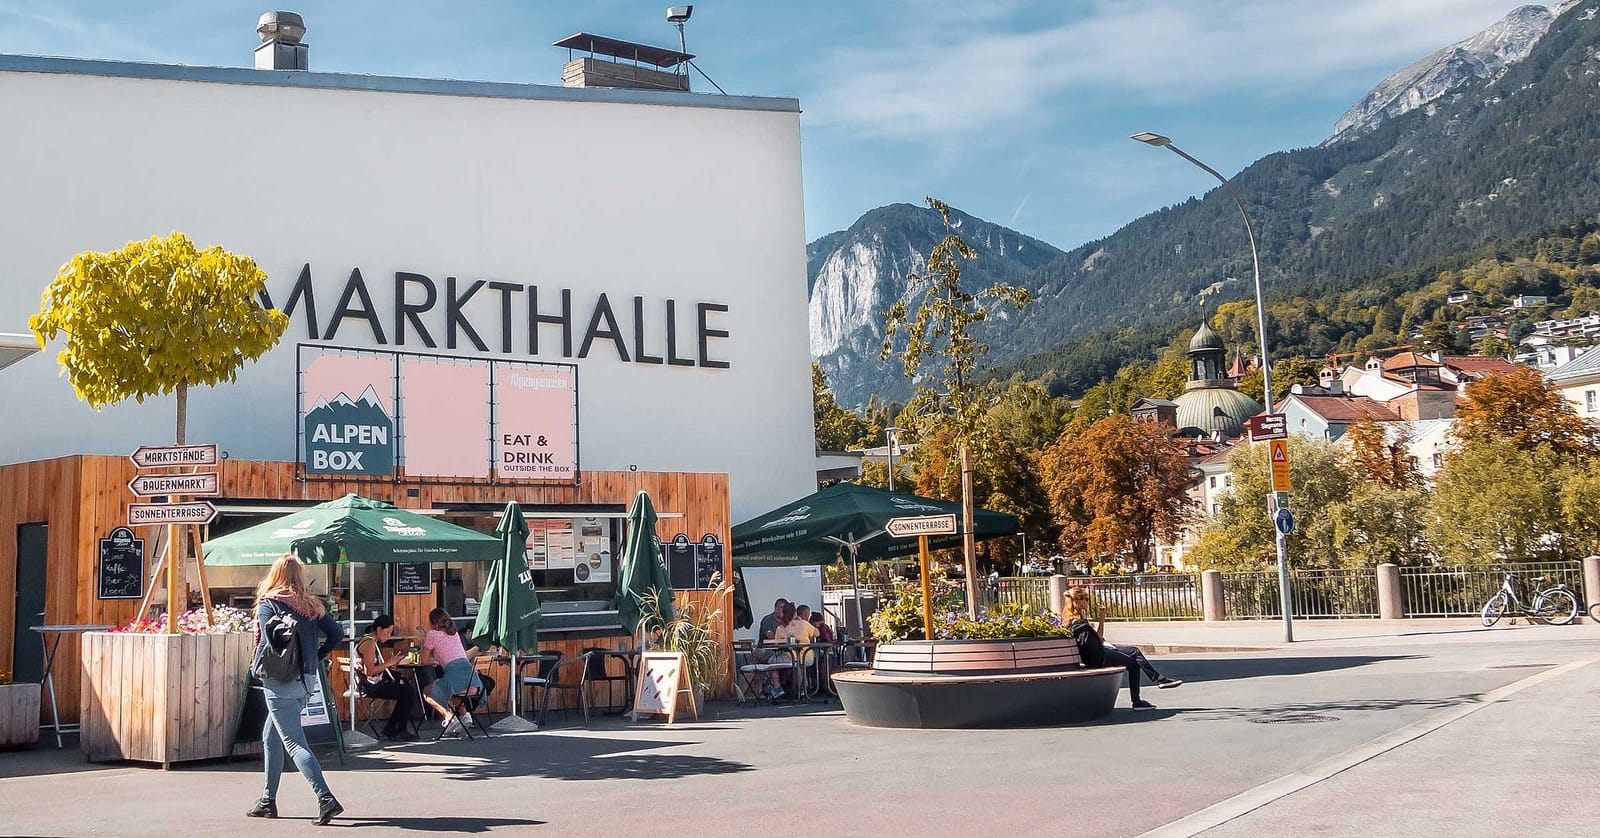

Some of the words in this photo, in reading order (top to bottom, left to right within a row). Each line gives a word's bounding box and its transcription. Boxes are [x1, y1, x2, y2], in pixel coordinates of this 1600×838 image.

[256, 262, 730, 369] MARKTHALLE
[311, 423, 388, 445] ALPEN
[503, 434, 532, 446] EAT
[536, 435, 548, 447] &
[144, 449, 206, 463] MARKTSTÄNDE
[313, 450, 364, 471] BOX
[503, 452, 554, 464] DRINK
[503, 464, 537, 472] OUTSIDE
[142, 478, 207, 491] BAUERNMARKT
[134, 508, 206, 519] SONNENTERRASSE
[893, 520, 950, 531] SONNENTERRASSE
